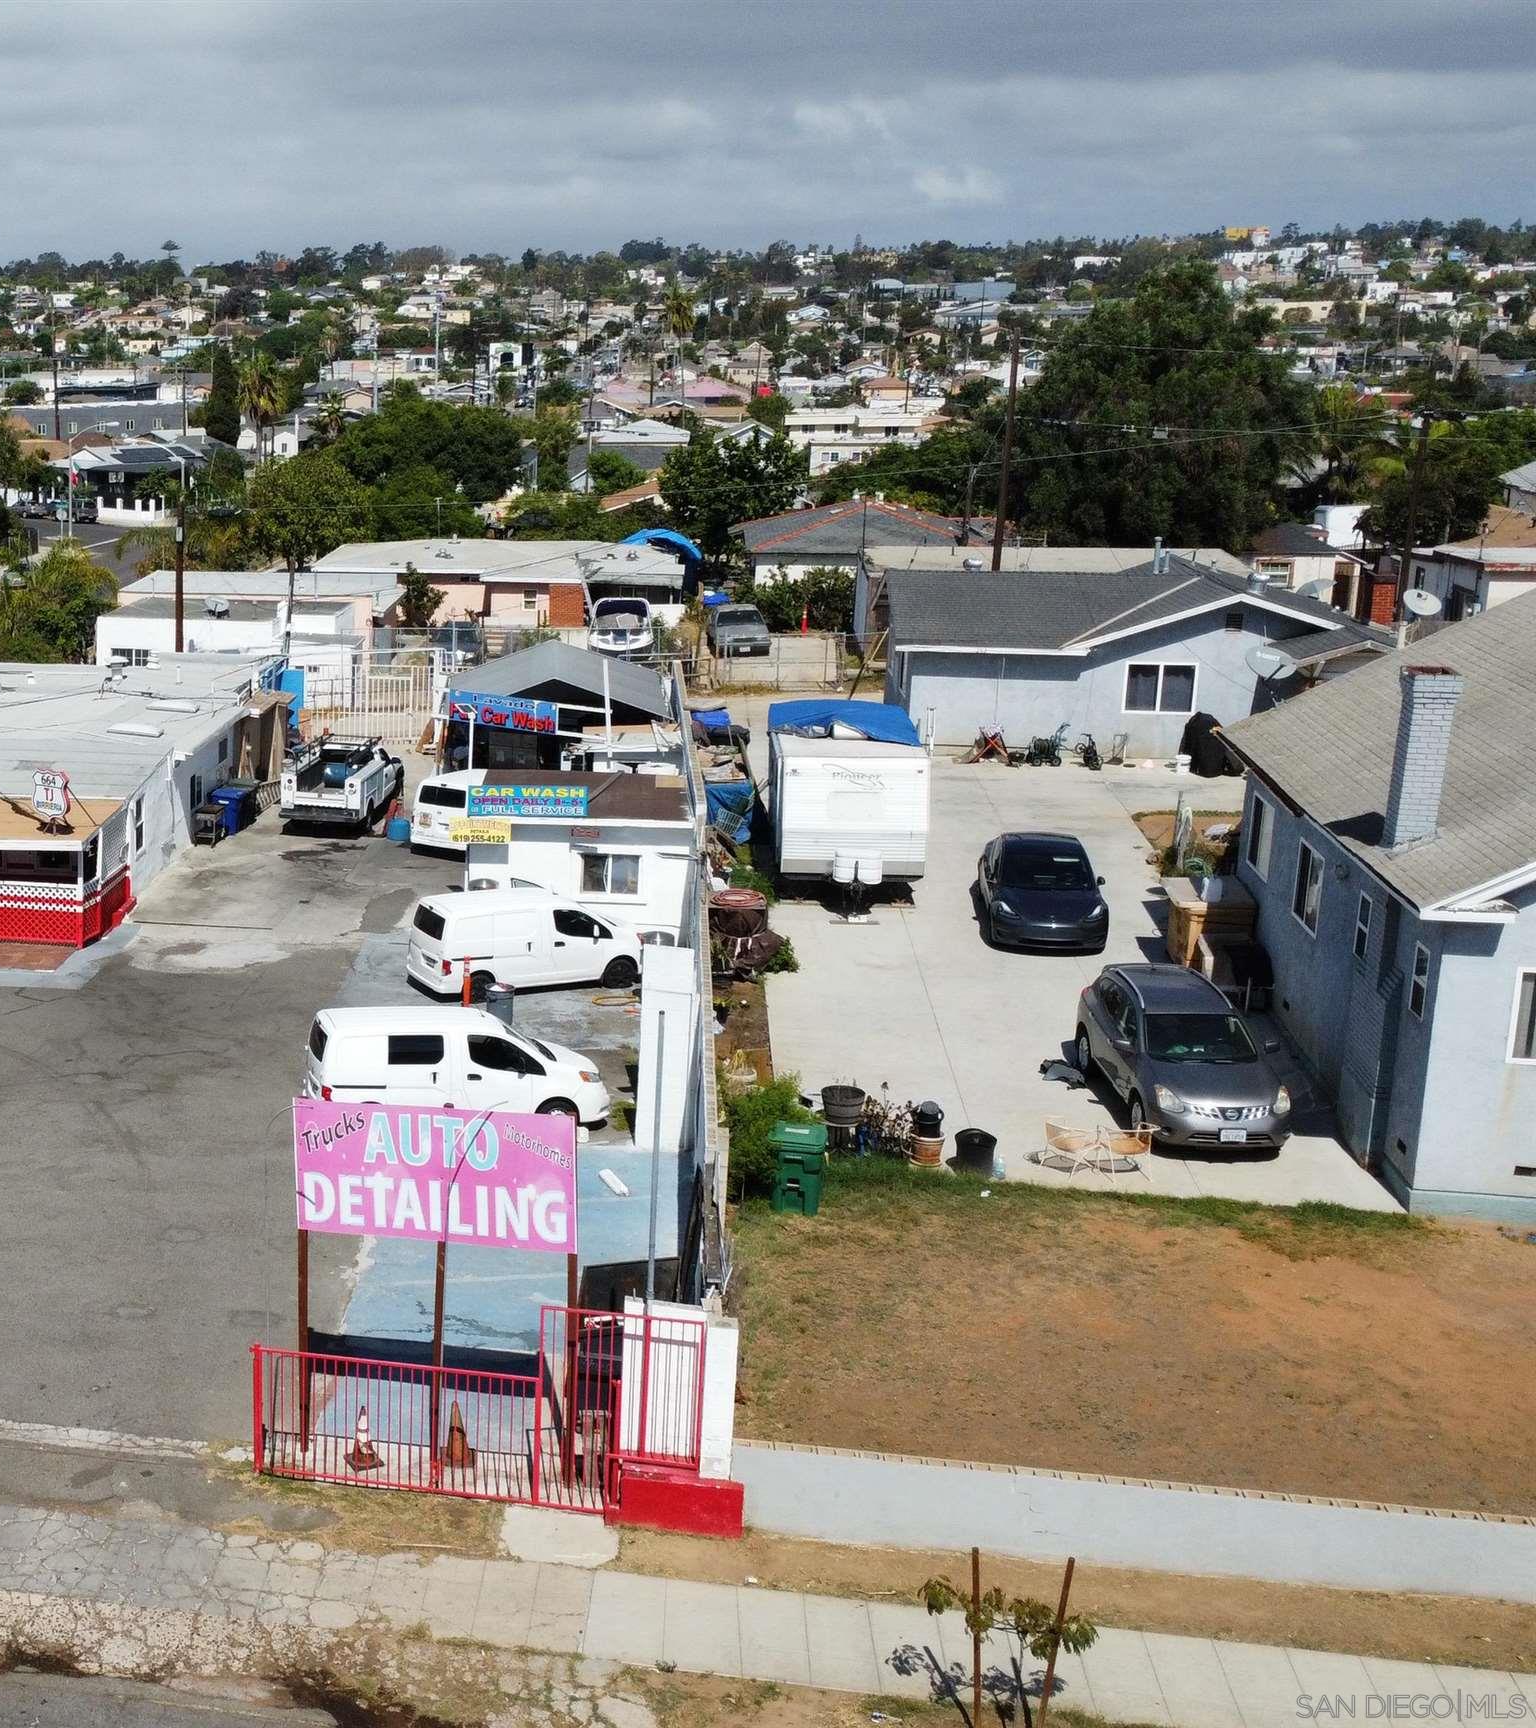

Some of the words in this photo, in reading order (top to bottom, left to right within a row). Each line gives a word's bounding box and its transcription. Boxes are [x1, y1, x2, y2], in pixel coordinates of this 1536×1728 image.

[472, 693, 536, 711] Lavado
[480, 706, 510, 727] Car
[511, 710, 557, 734] Wash
[41, 775, 56, 786] 664
[44, 788, 54, 802] TJ
[470, 787, 515, 797] CAR
[521, 787, 585, 798] WASH
[472, 797, 509, 805] OPEN
[512, 797, 550, 806] DAILY
[480, 804, 518, 815] FULL
[520, 804, 584, 816] SERVICE
[301, 1109, 366, 1153] Trucks
[364, 1110, 501, 1172] AUTO
[302, 1171, 568, 1244] DETAILING
